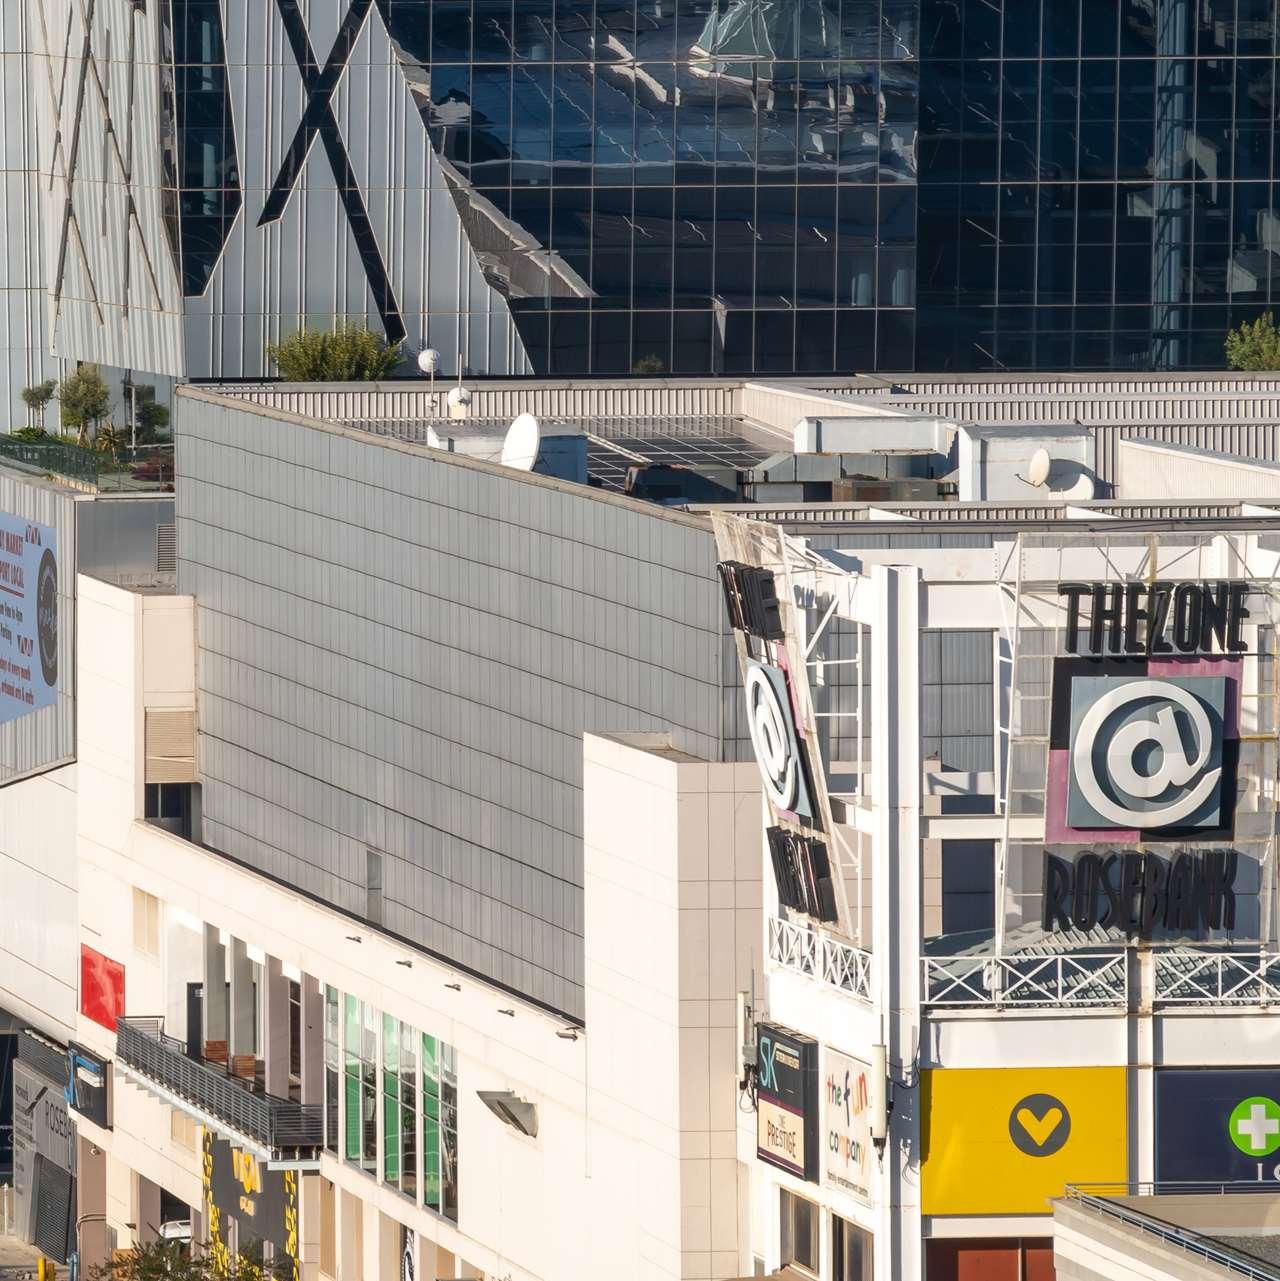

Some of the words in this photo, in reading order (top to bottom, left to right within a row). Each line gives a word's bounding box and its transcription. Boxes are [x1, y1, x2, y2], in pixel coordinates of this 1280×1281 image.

[1042, 847, 1240, 933] ROSEBANK
[759, 1036, 779, 1092] SK
[827, 1073, 842, 1107] the
[844, 1070, 868, 1127] fun
[767, 1120, 797, 1159] PRESTIGE
[829, 1130, 866, 1176] company
